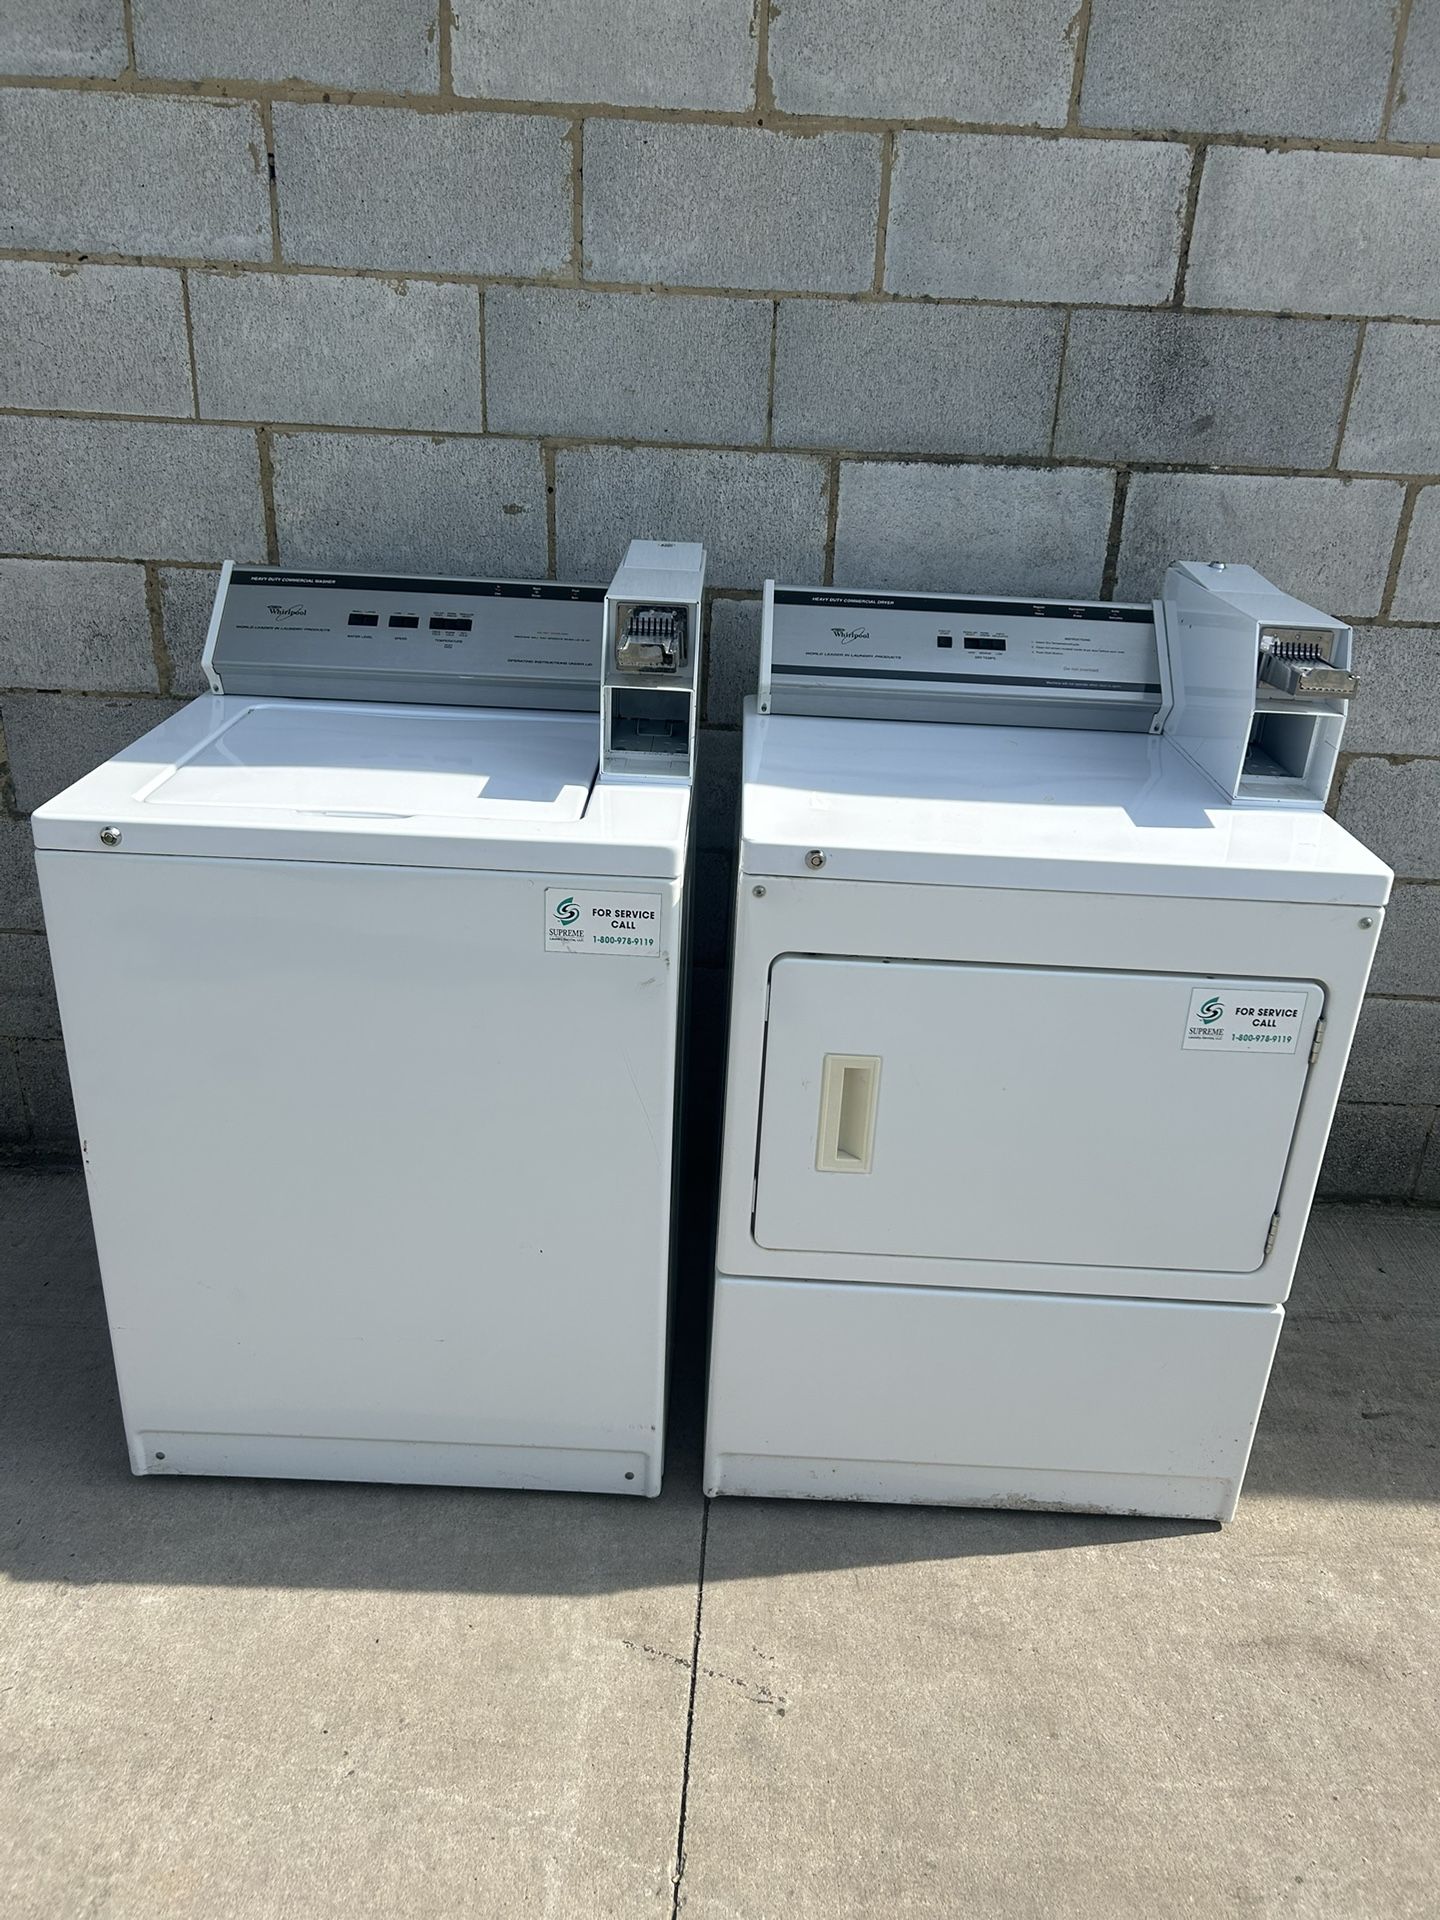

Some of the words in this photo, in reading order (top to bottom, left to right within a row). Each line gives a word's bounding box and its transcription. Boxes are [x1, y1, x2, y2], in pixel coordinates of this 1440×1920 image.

[267, 604, 307, 620] Whirlpool
[831, 627, 870, 644] Whirlpool
[592, 908, 611, 917] FOR
[615, 909, 655, 920] SERVICE
[611, 920, 636, 930] CALL
[549, 928, 584, 937] SUPREME
[593, 935, 654, 946] 1-800-978-9119
[1235, 1007, 1255, 1016] FOR
[1257, 1008, 1298, 1018] SERVICE
[1252, 1018, 1276, 1028] CALL
[1188, 1027, 1224, 1036] SUPREME
[1231, 1033, 1292, 1043] 1-800-978-9119
